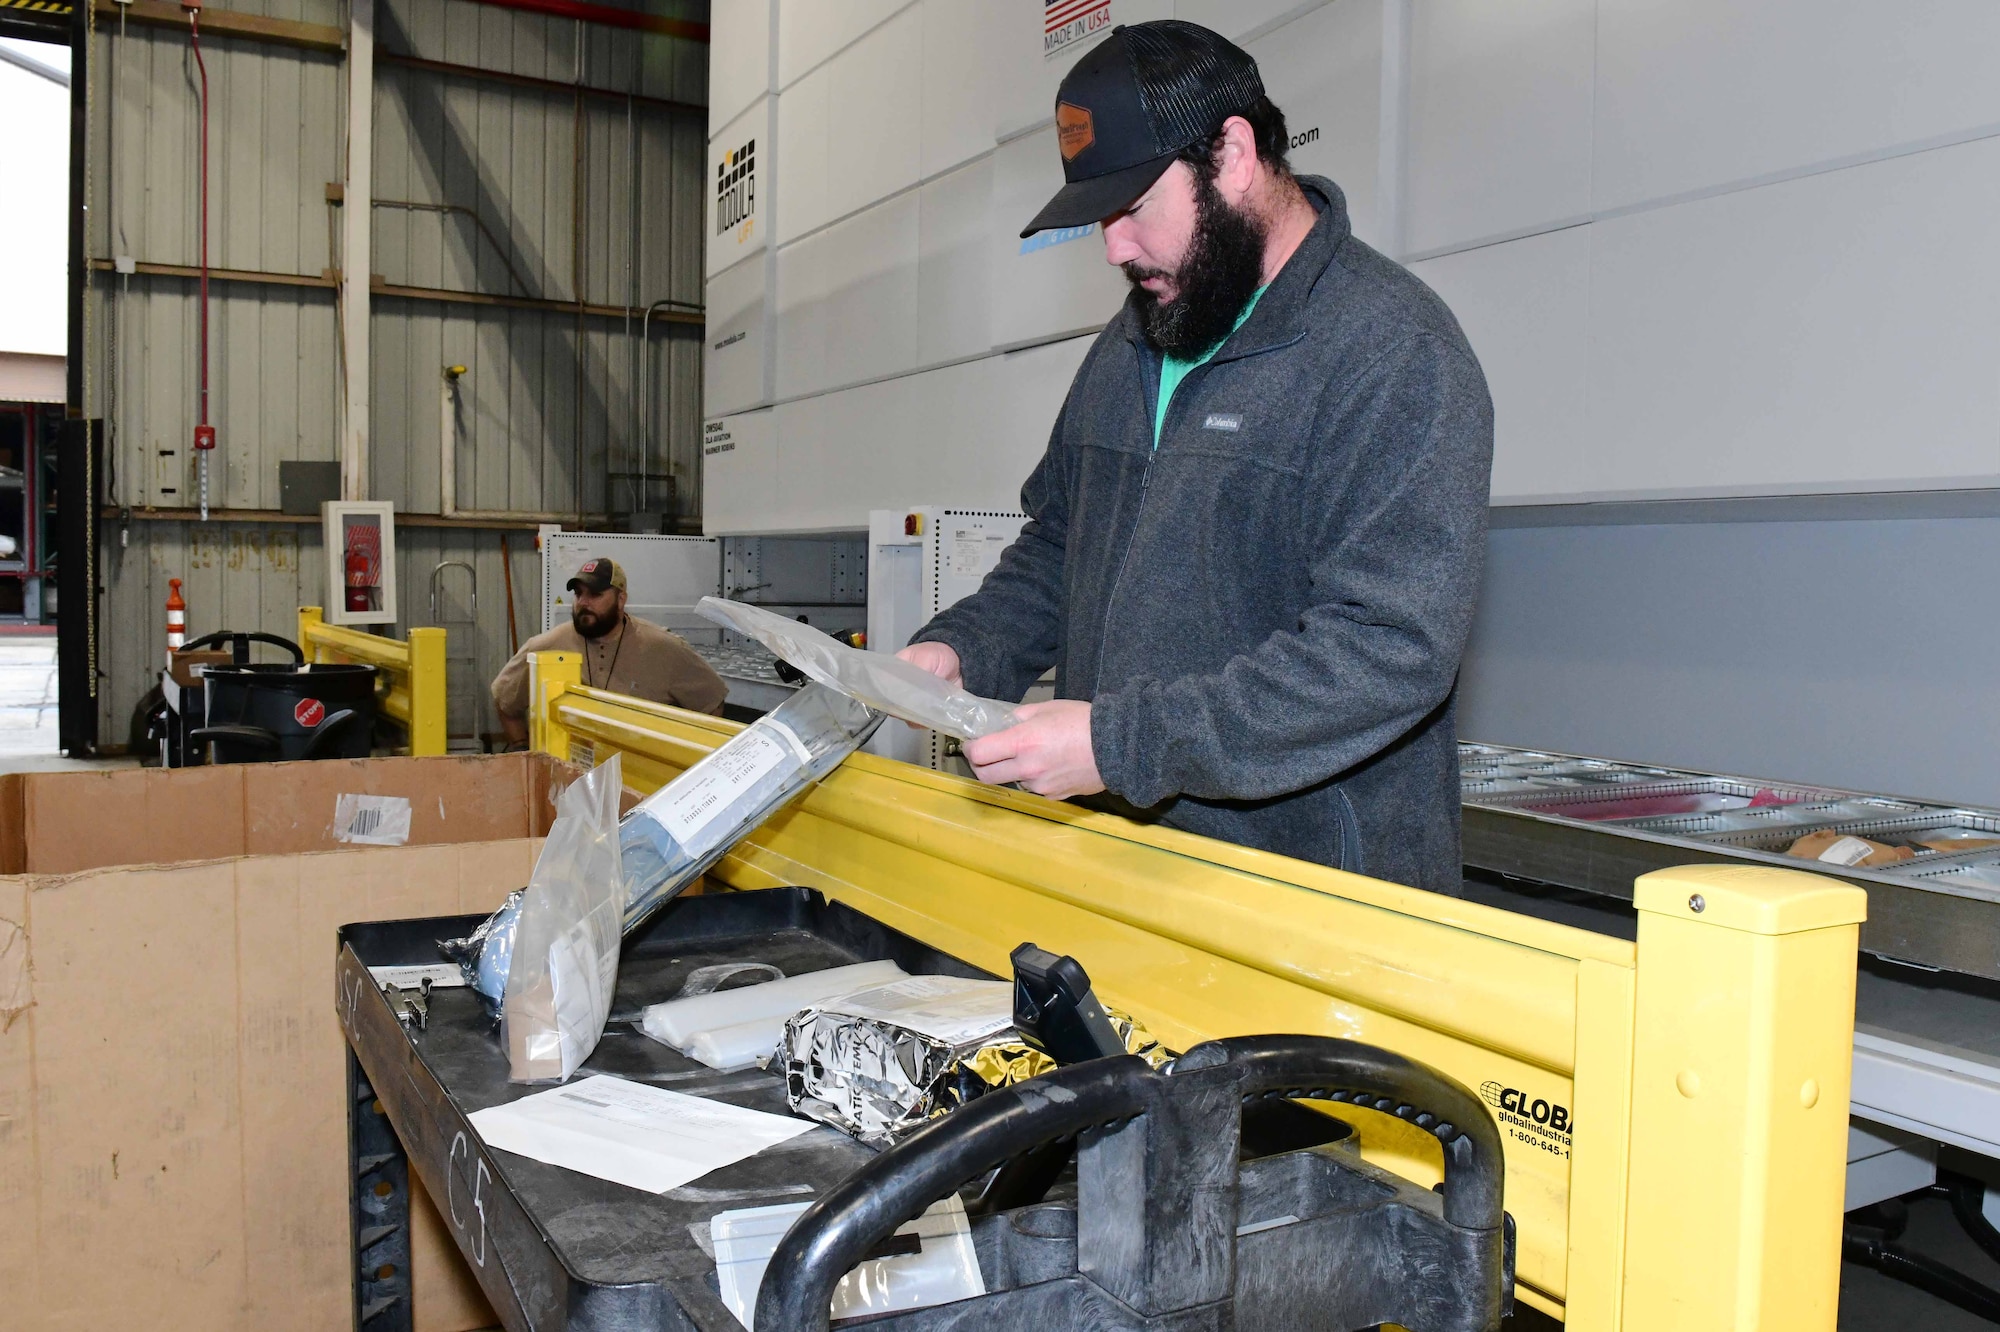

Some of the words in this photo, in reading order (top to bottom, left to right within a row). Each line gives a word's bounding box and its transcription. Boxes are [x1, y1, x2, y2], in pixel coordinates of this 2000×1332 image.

[1044, 25, 1072, 51] MADE
[1075, 19, 1086, 37] IN
[1088, 8, 1111, 30] USA
[717, 174, 755, 236] MODULA
[737, 219, 754, 244] LIFT
[1050, 223, 1094, 243] Group
[1211, 416, 1238, 429] Columbia
[1509, 1128, 1570, 1160] 1-800-645-1
